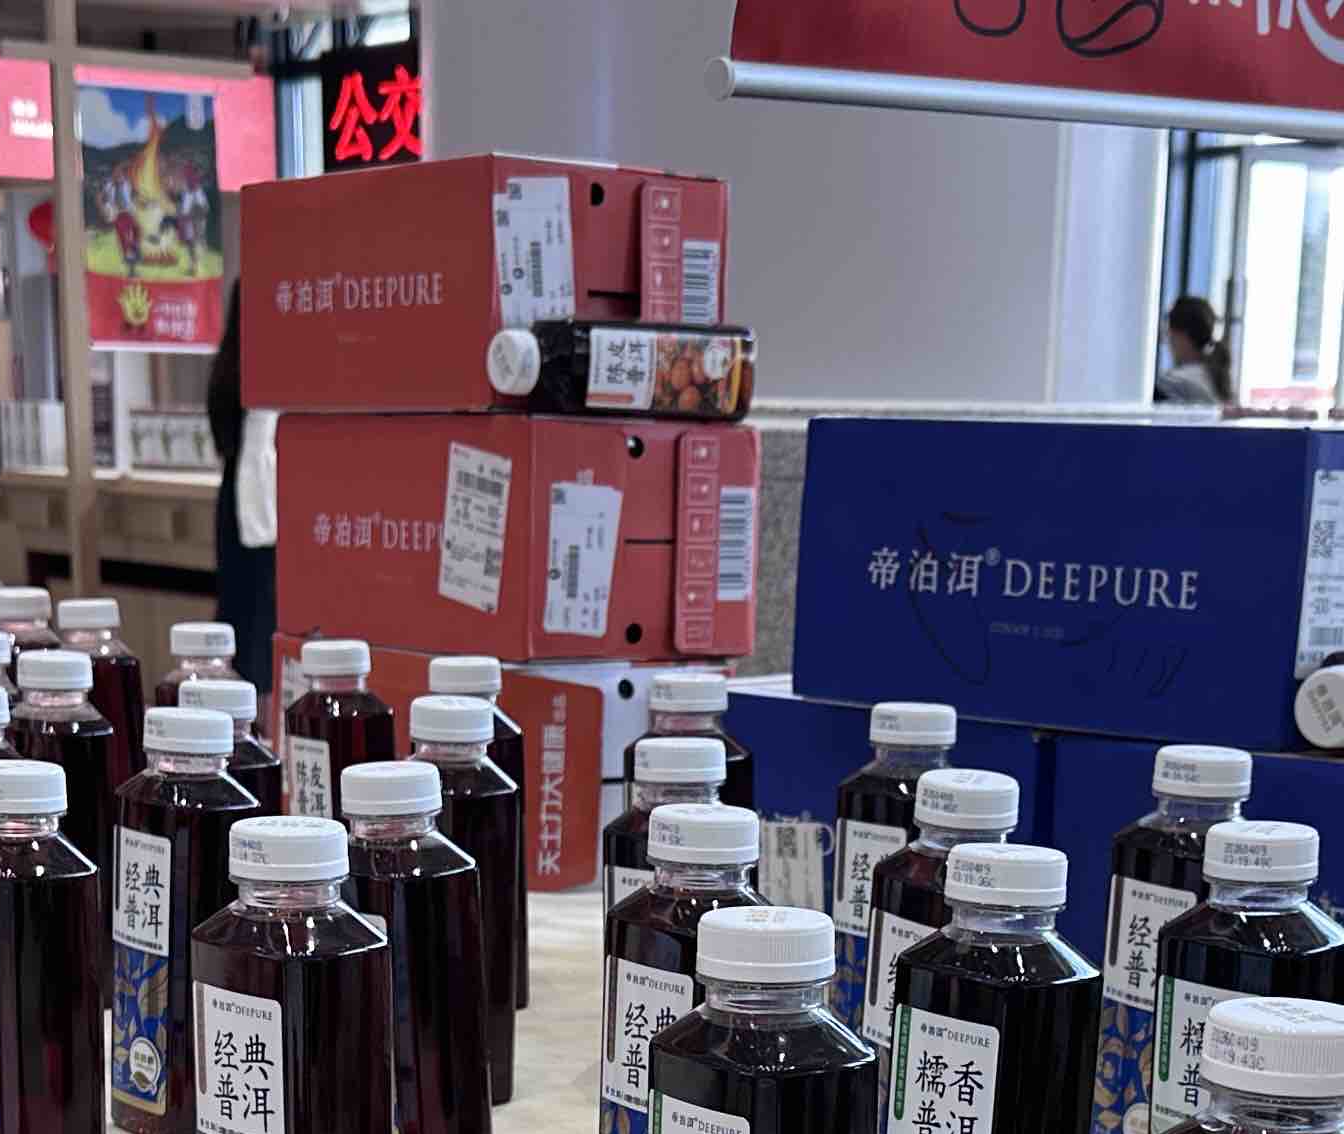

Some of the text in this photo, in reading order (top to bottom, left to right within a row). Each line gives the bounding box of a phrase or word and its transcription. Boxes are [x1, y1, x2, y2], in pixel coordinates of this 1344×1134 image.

[330, 64, 424, 162] 公交
[343, 271, 445, 311] DEEPURE
[382, 515, 445, 552] DEEP
[1003, 558, 1201, 611] DEEPURE
[123, 861, 166, 903] 经典
[123, 897, 165, 939] 普洱
[212, 1028, 275, 1081] 经典
[914, 1050, 985, 1107] 糯香
[212, 1074, 276, 1133] 普洱
